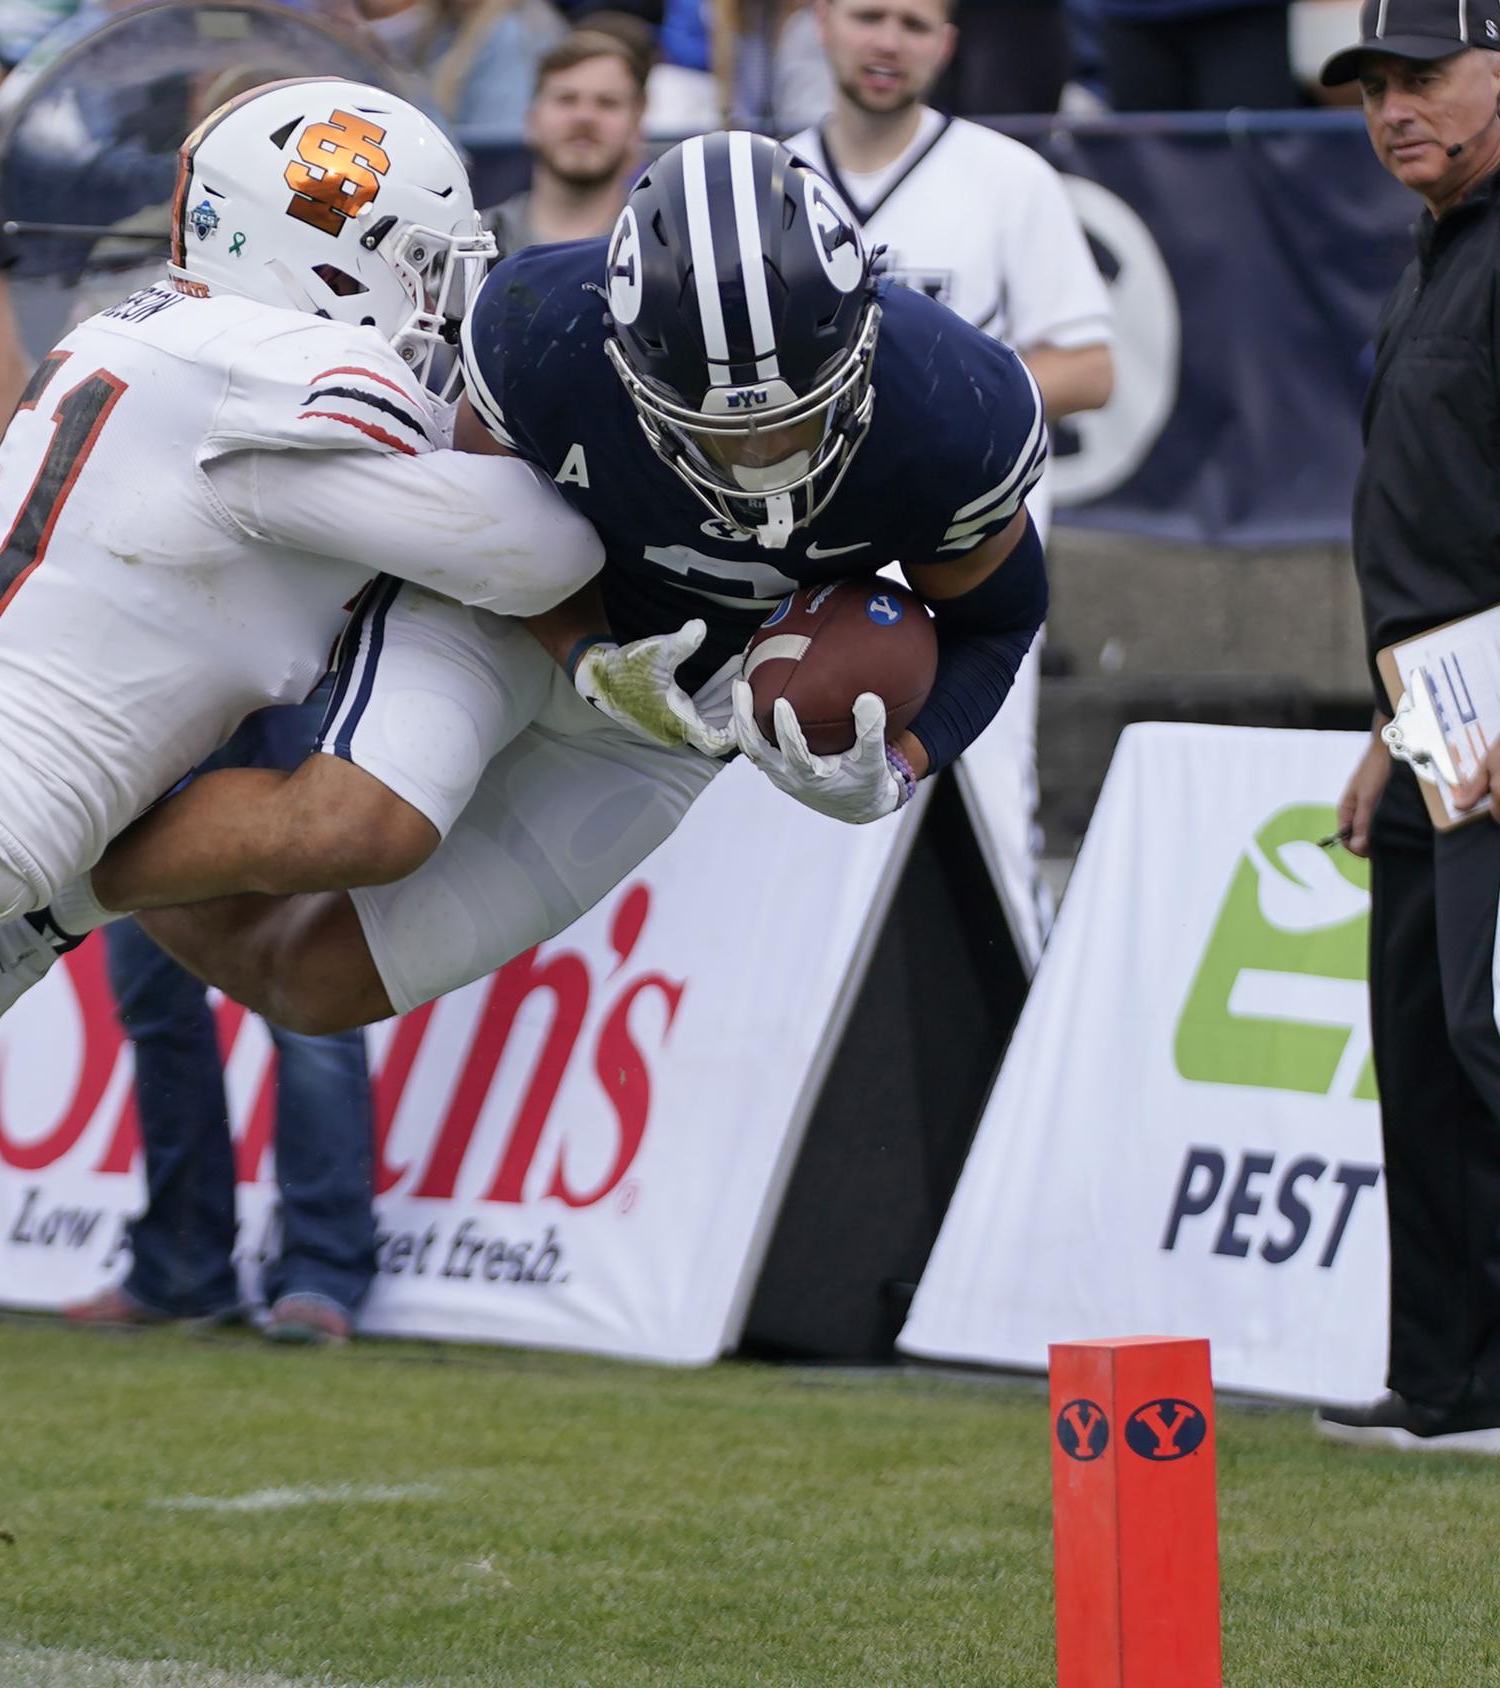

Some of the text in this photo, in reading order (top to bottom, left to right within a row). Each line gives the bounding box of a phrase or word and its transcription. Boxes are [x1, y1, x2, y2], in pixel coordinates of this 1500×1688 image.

[726, 389, 768, 408] BYU
[554, 443, 590, 488] A
[870, 595, 898, 621] Y
[1160, 1144, 1381, 1269] PEST
[10, 1186, 102, 1248] Low
[441, 1217, 570, 1285] fresh.
[1063, 1404, 1102, 1456] Y
[1135, 1404, 1196, 1456] Y
